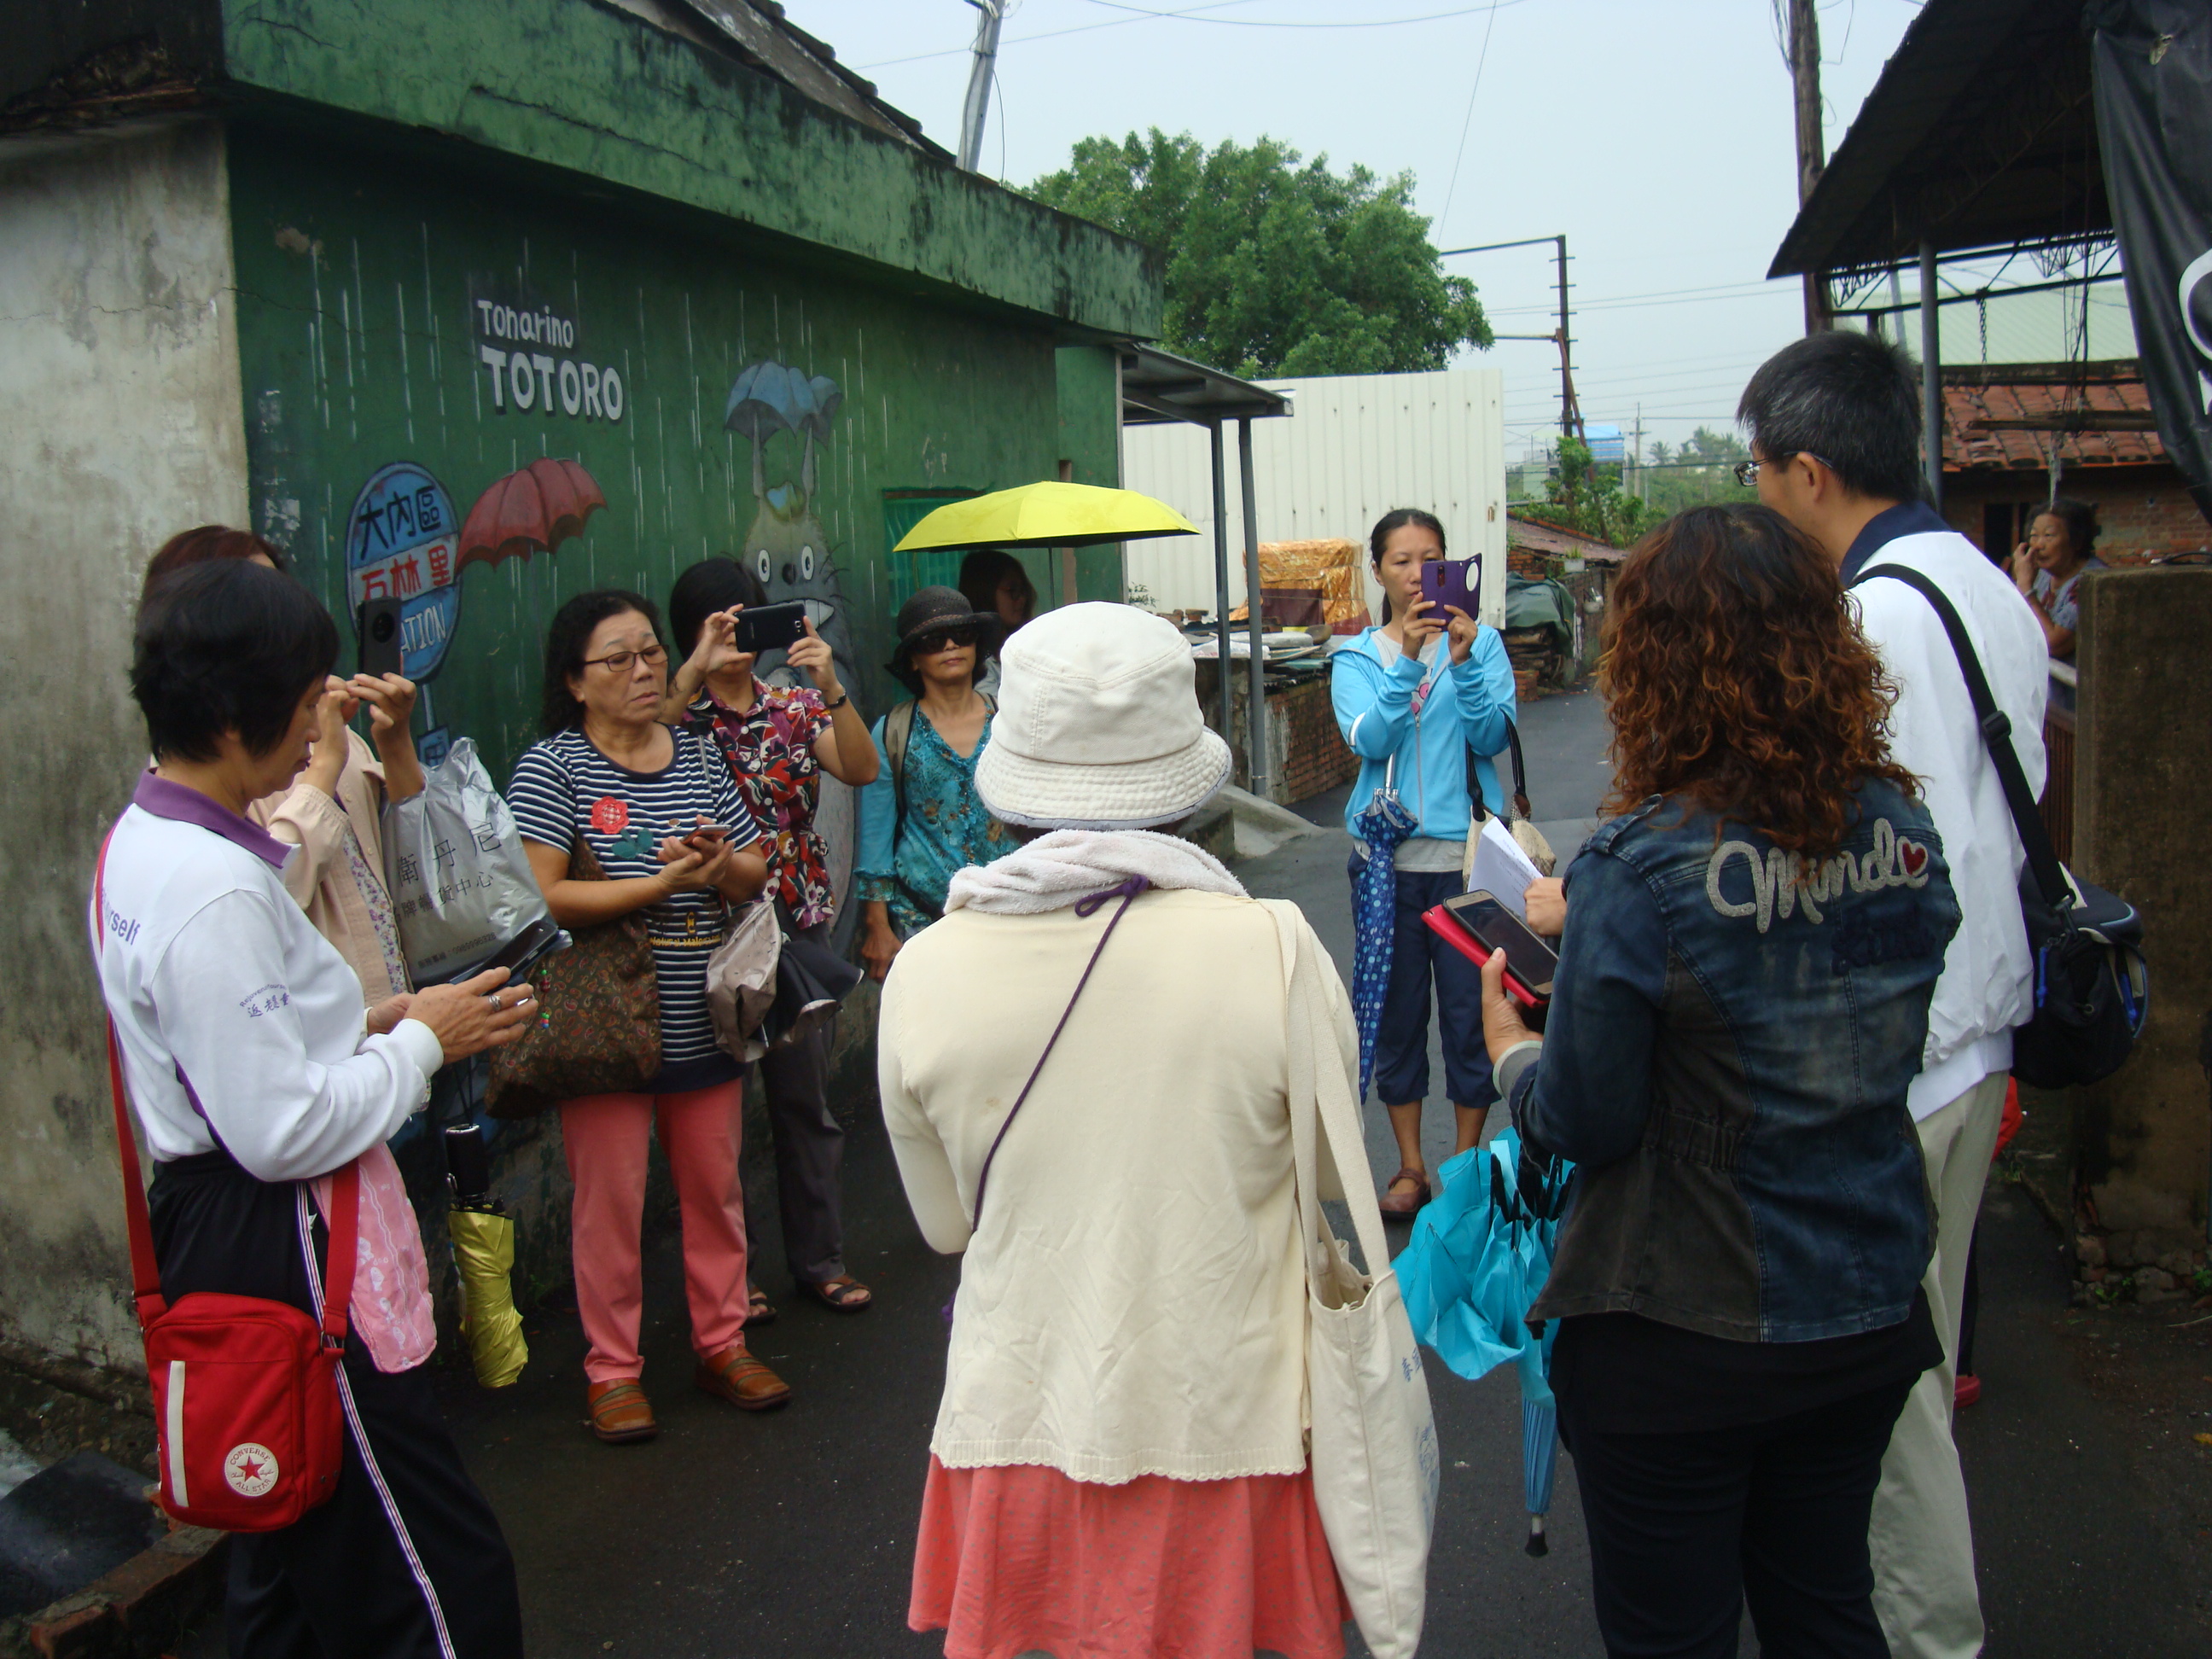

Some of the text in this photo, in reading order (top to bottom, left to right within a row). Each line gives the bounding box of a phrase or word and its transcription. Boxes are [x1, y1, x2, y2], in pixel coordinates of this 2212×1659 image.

[477, 300, 574, 349] Tonarino
[481, 345, 624, 421] TOTORO
[400, 602, 445, 652] ATION
[230, 1447, 271, 1465] CONVERSE
[236, 1478, 271, 1493] ALL STAR
